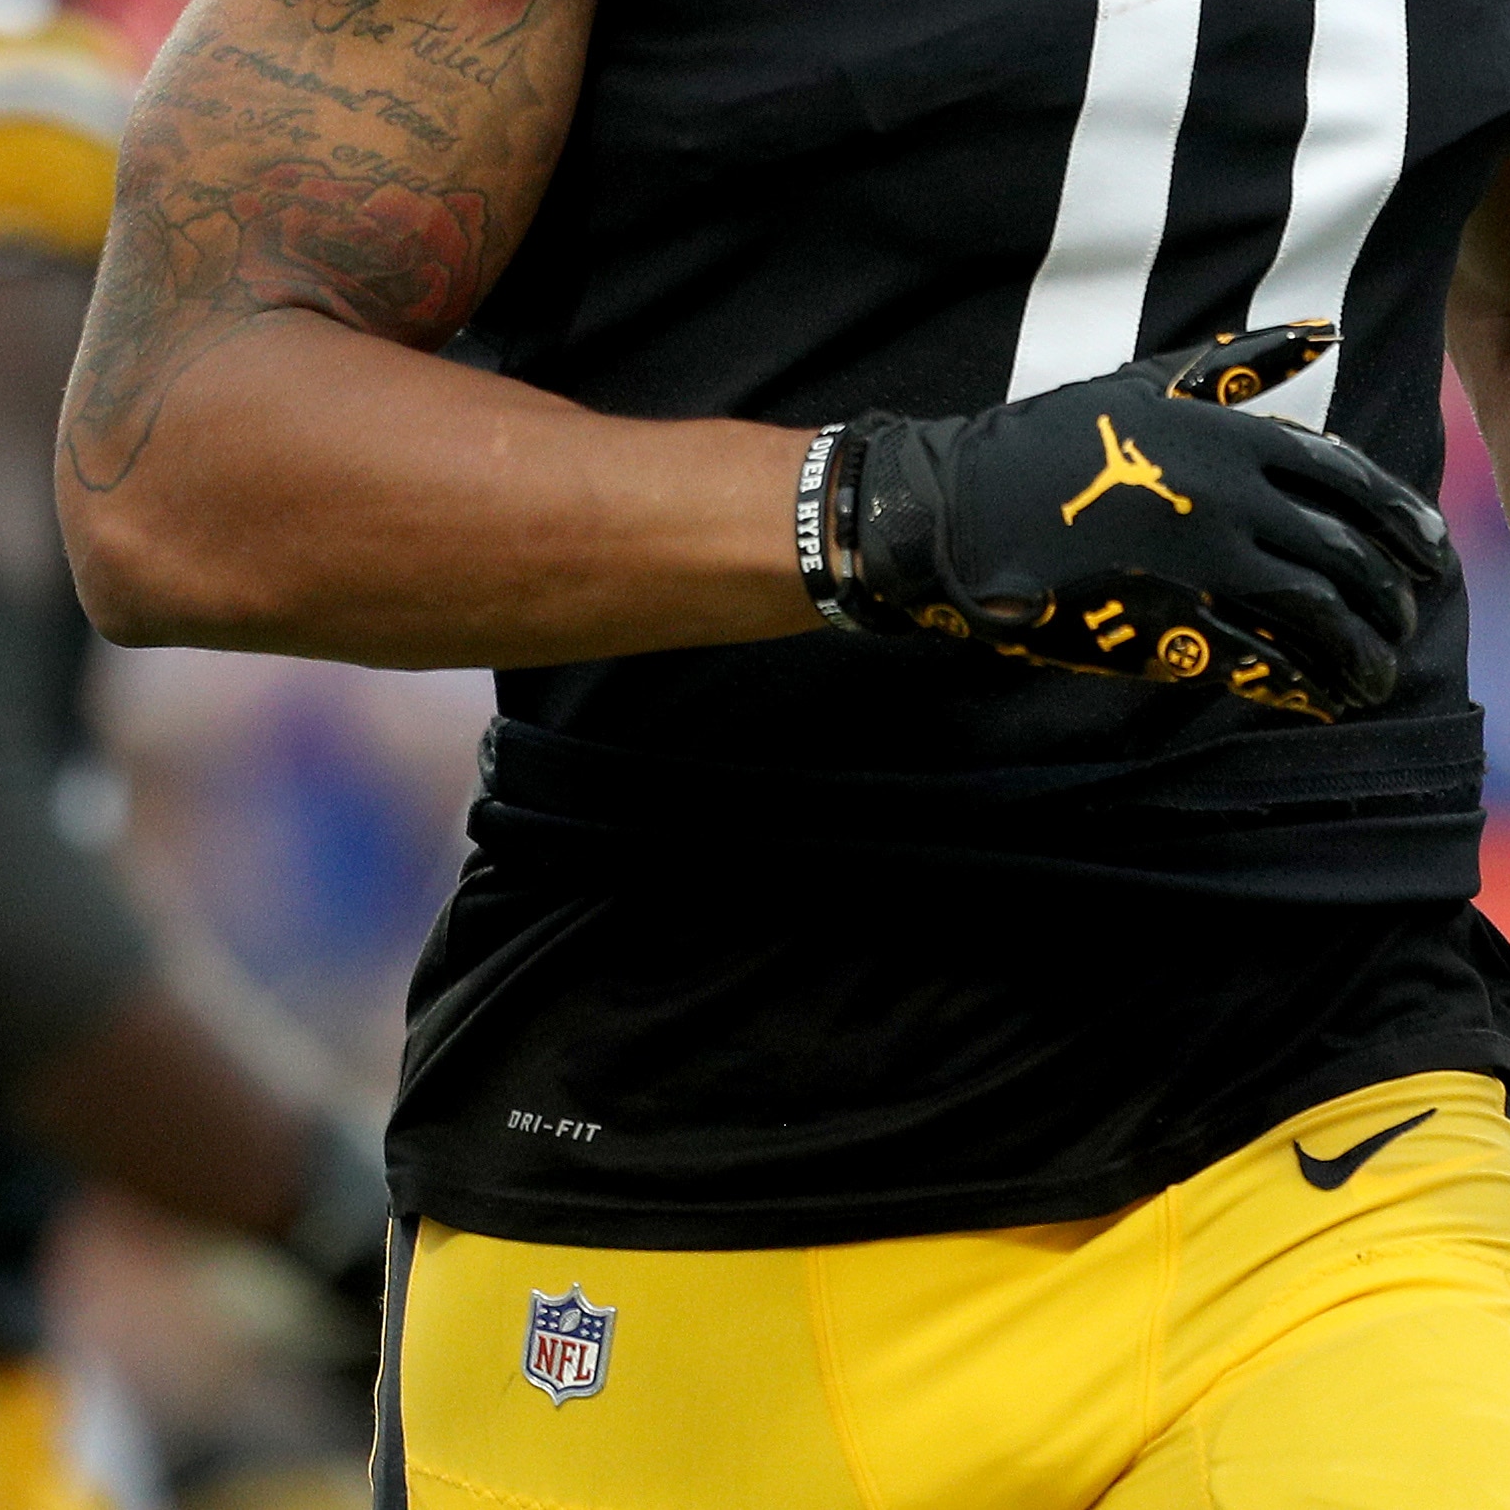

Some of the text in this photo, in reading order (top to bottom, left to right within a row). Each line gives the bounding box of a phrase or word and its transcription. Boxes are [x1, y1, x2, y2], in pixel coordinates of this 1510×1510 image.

[798, 435, 835, 493] OVER
[796, 501, 824, 574] HYPE
[507, 1109, 602, 1143] DRI-FIT
[533, 1334, 594, 1383] NFL
